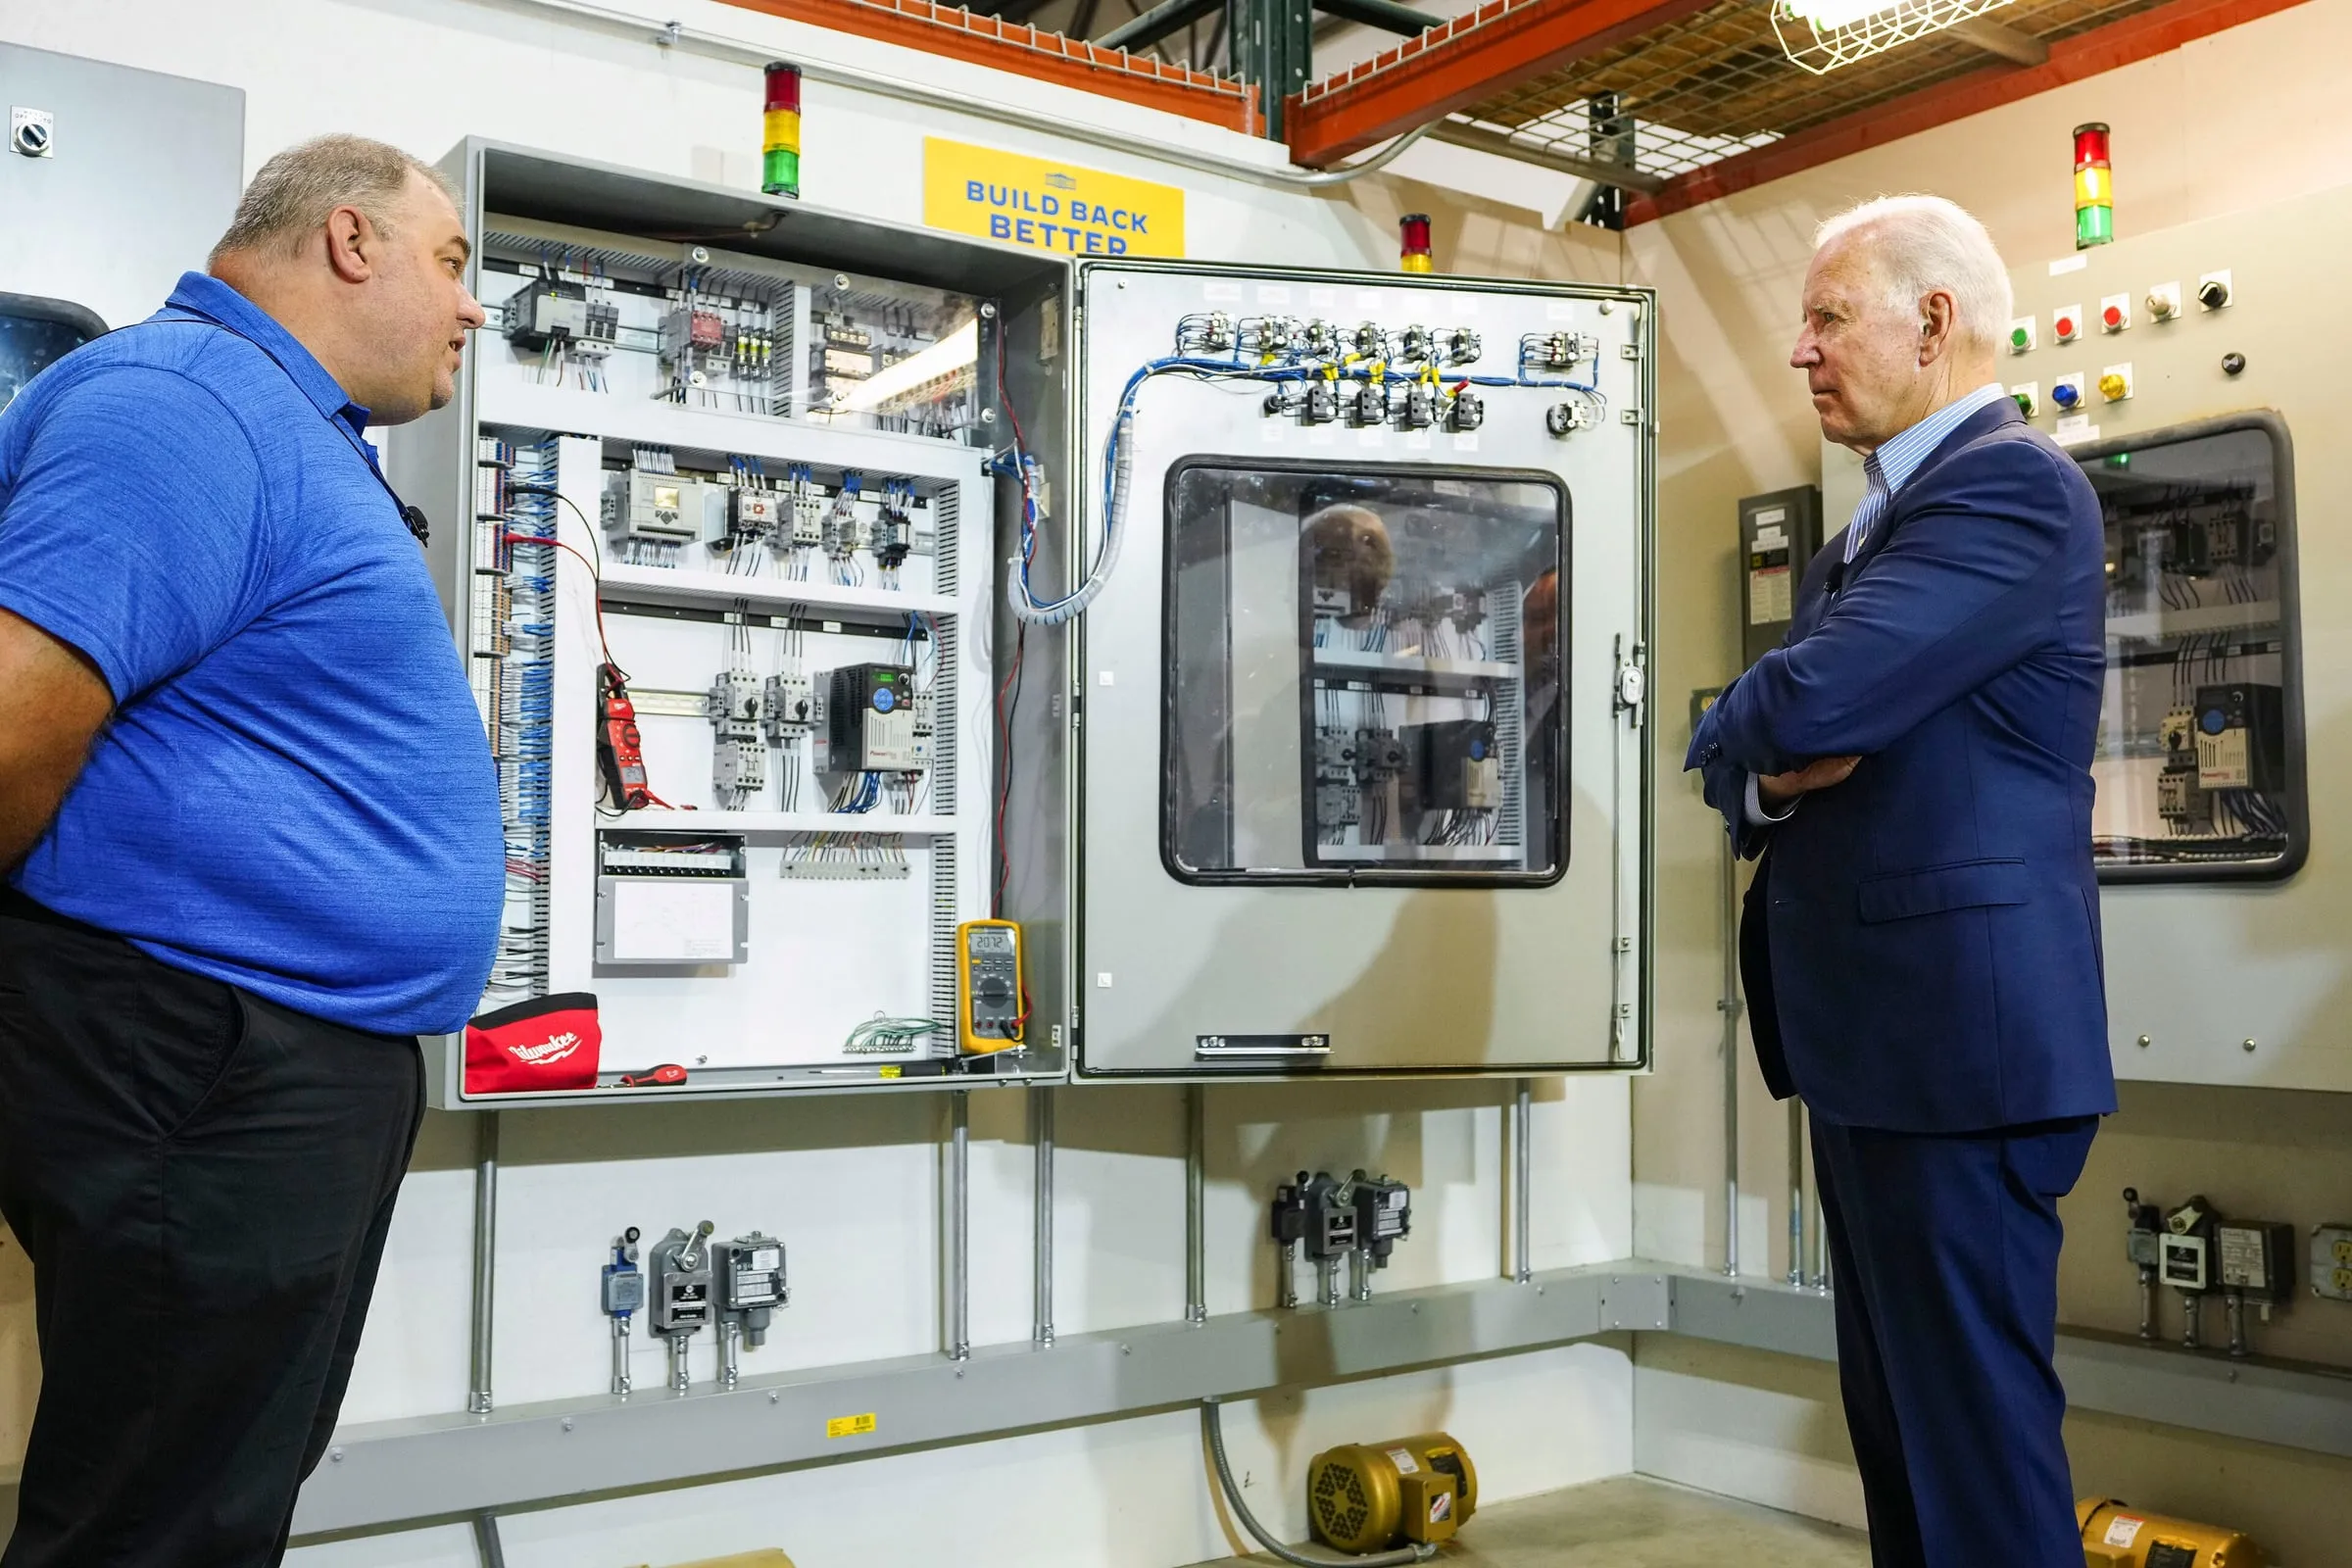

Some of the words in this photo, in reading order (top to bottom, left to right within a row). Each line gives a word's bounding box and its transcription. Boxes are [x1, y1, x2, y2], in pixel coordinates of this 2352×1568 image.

[967, 180, 1059, 216] BUILD
[1071, 201, 1148, 233] BACK
[991, 214, 1126, 254] BETTER
